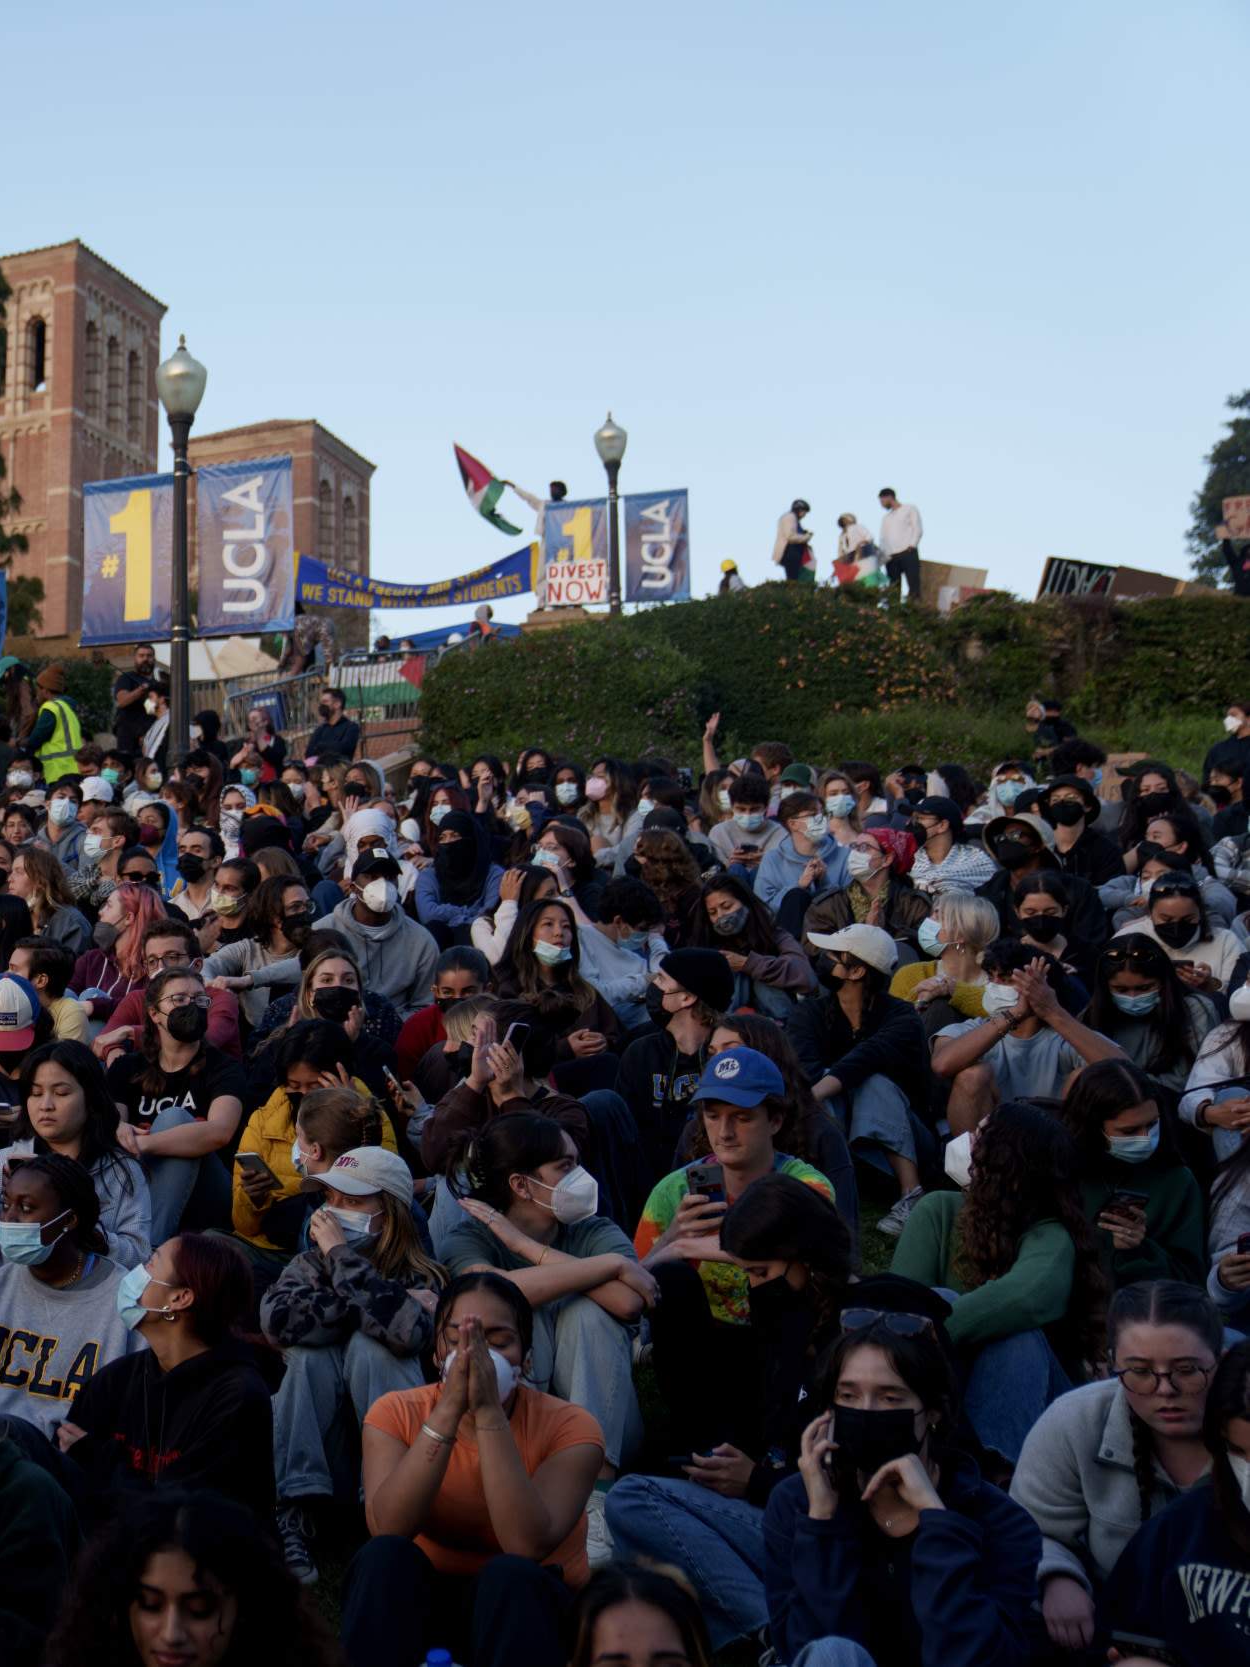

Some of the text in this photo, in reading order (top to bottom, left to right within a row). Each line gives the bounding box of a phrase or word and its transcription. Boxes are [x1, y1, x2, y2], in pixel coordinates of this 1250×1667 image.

[101, 488, 152, 622] #1
[222, 476, 265, 613] UCLA
[640, 500, 672, 588] UCLA
[327, 567, 363, 590] UCLA
[549, 563, 604, 579] DIVEST
[302, 583, 324, 601] WE
[327, 588, 374, 607] STAND
[453, 573, 522, 603] STUDENTS
[548, 580, 603, 602] NOW
